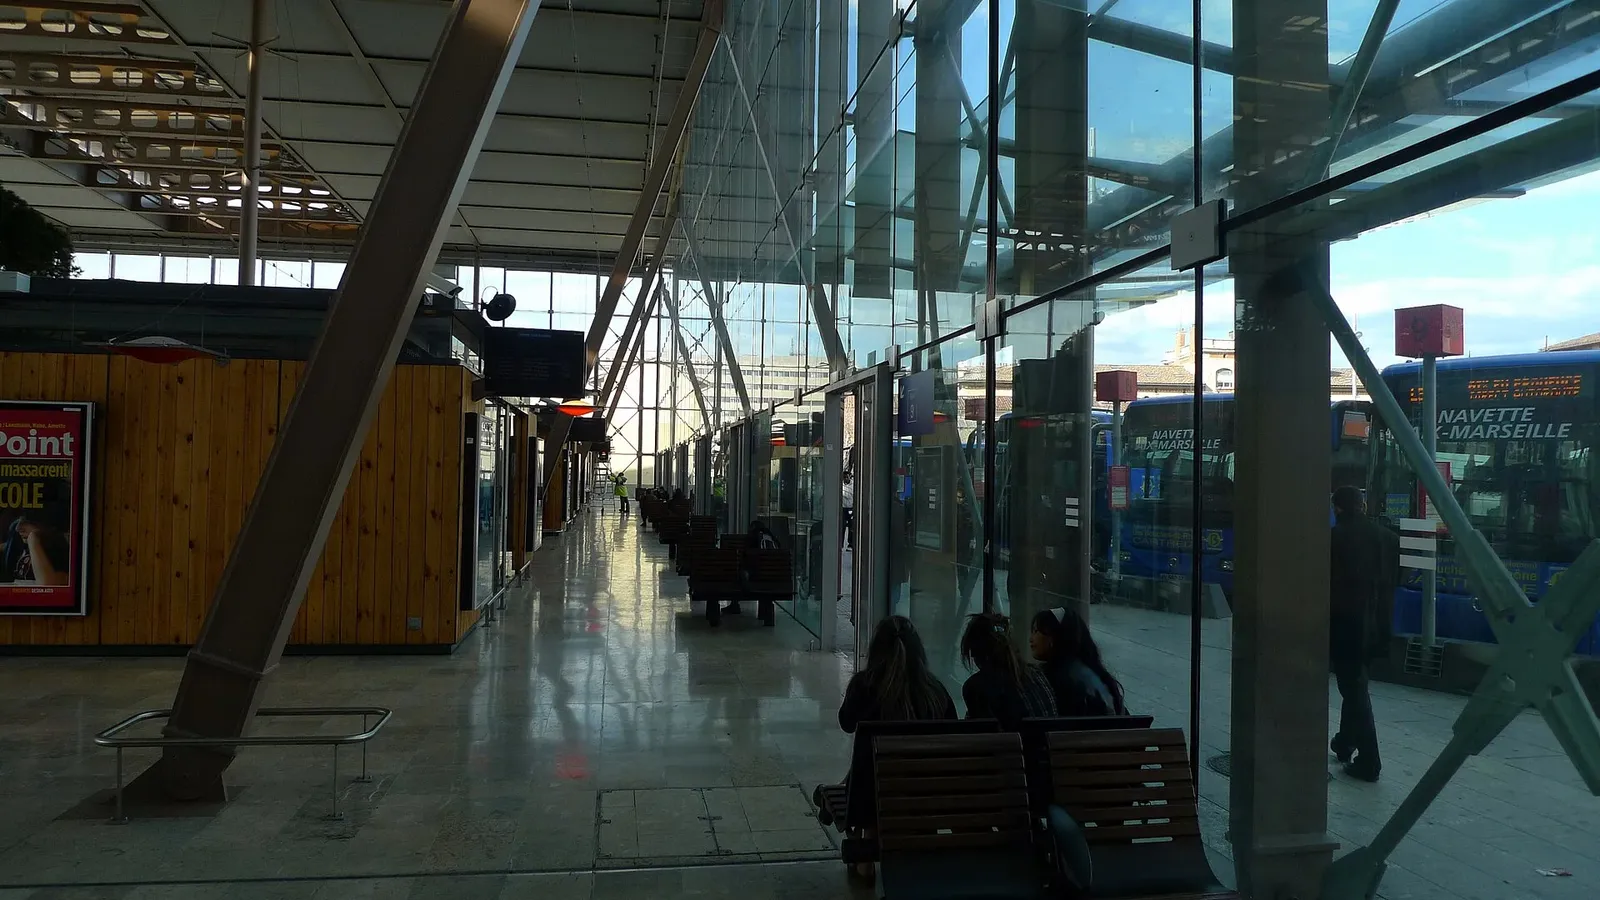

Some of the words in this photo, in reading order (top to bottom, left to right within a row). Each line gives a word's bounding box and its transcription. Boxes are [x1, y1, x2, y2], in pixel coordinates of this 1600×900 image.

[1438, 407, 1536, 424] NAVETTE
[1152, 428, 1195, 440] NAVETT
[1413, 423, 1572, 440] AX-MARSEILLE
[0, 463, 69, 478] massacrent
